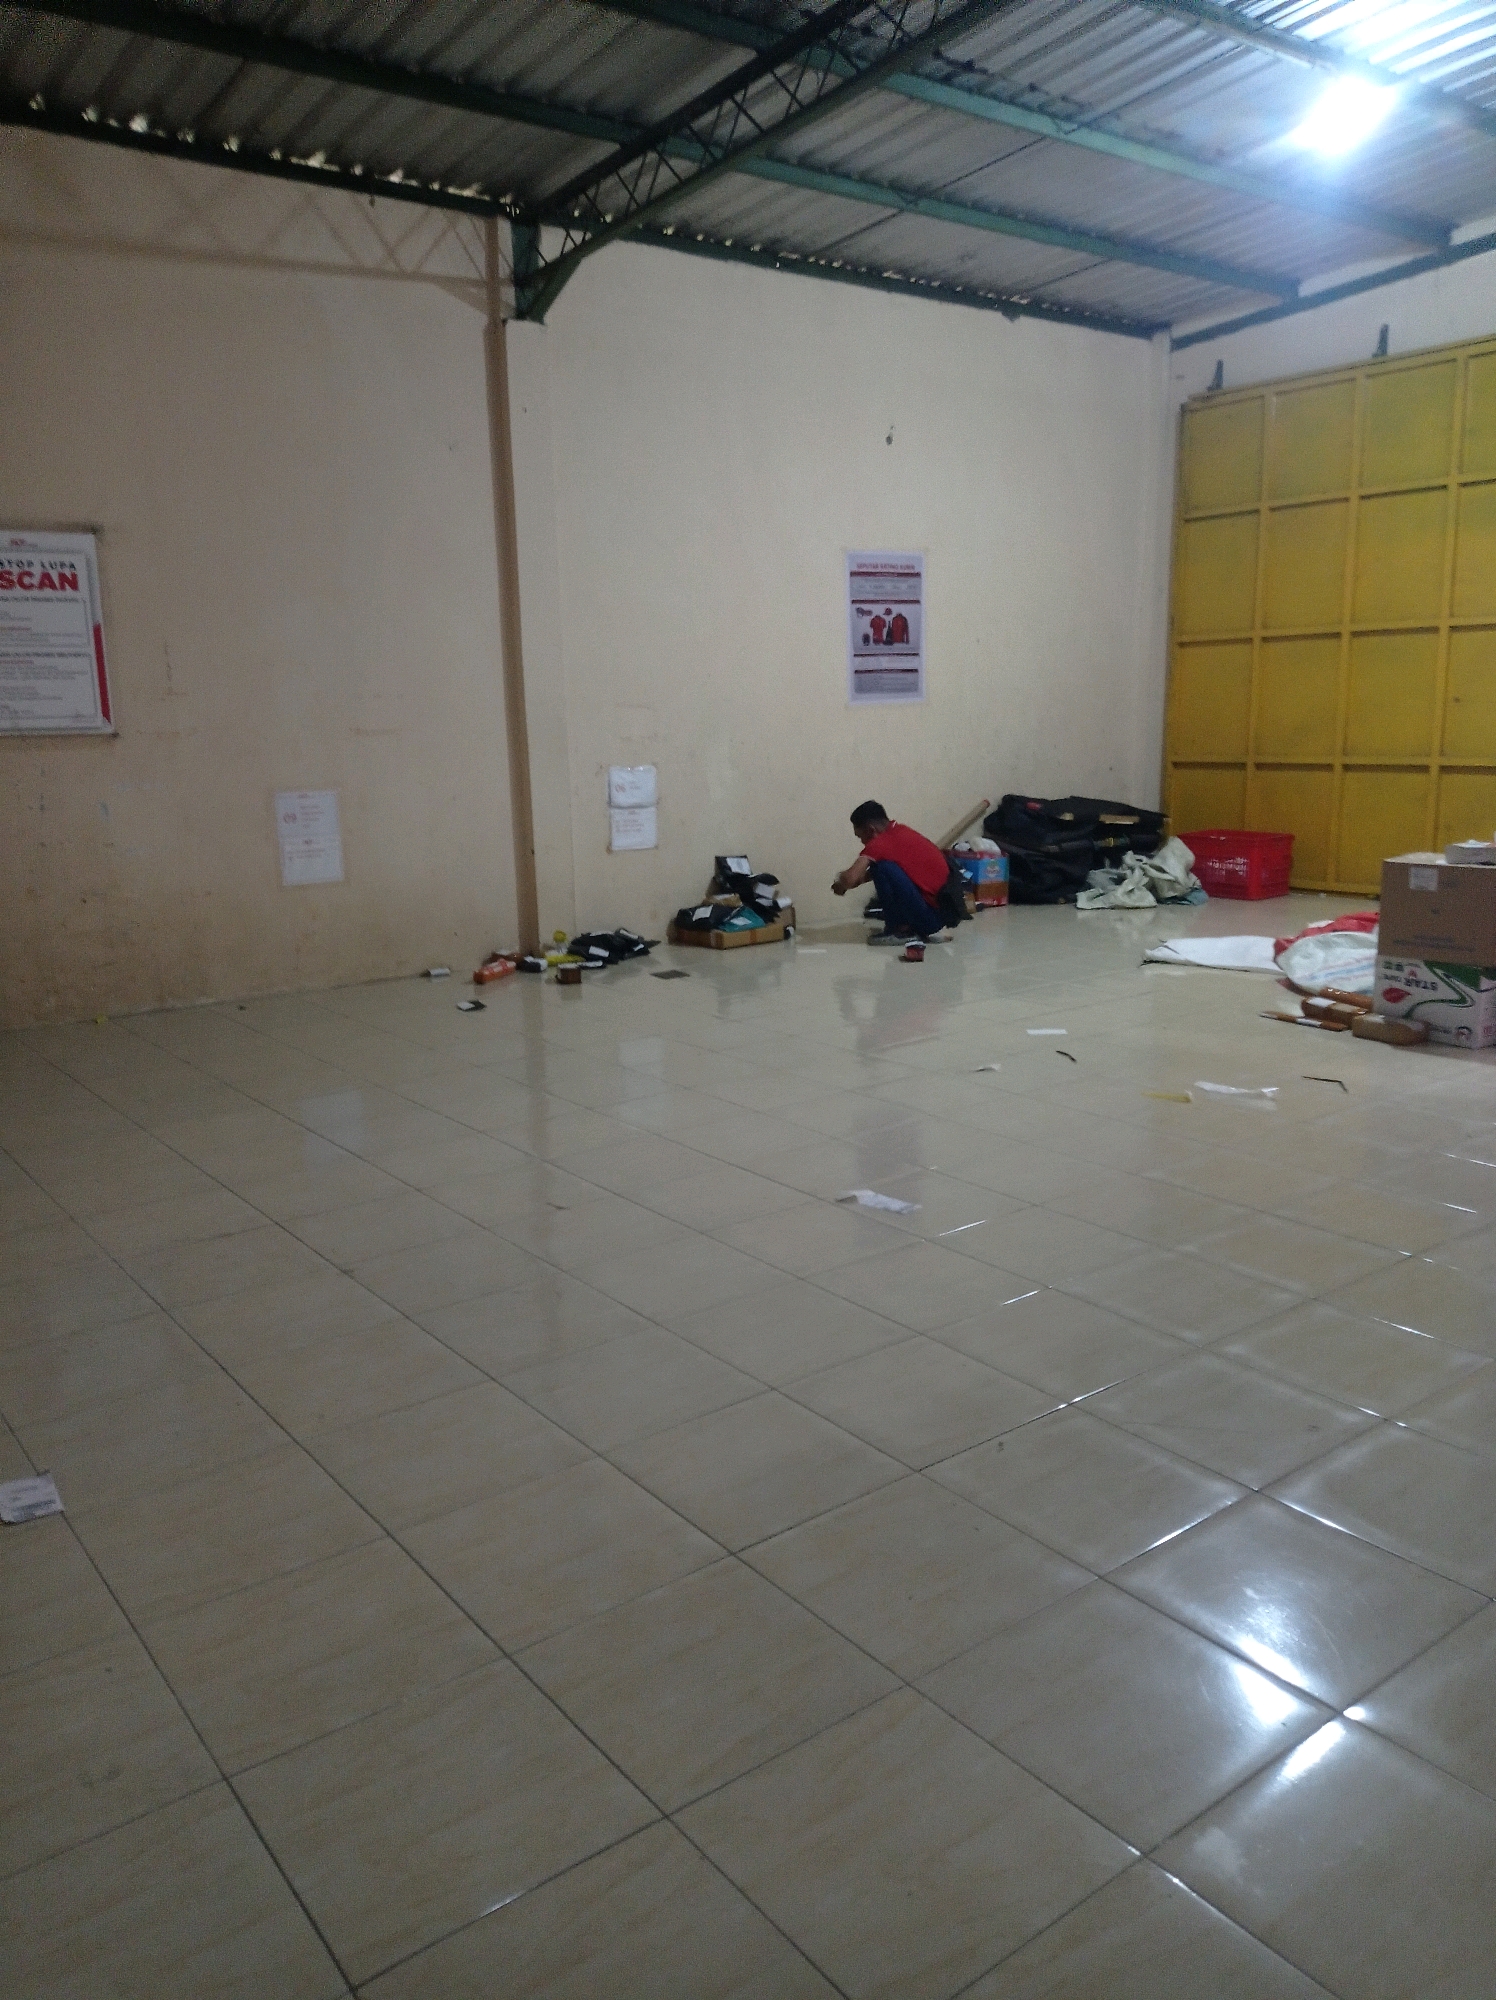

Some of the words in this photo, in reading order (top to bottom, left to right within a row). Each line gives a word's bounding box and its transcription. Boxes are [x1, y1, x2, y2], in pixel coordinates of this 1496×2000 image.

[41, 560, 77, 571] LUPA
[0, 570, 80, 591] SCAN
[1403, 978, 1439, 990] STAR
